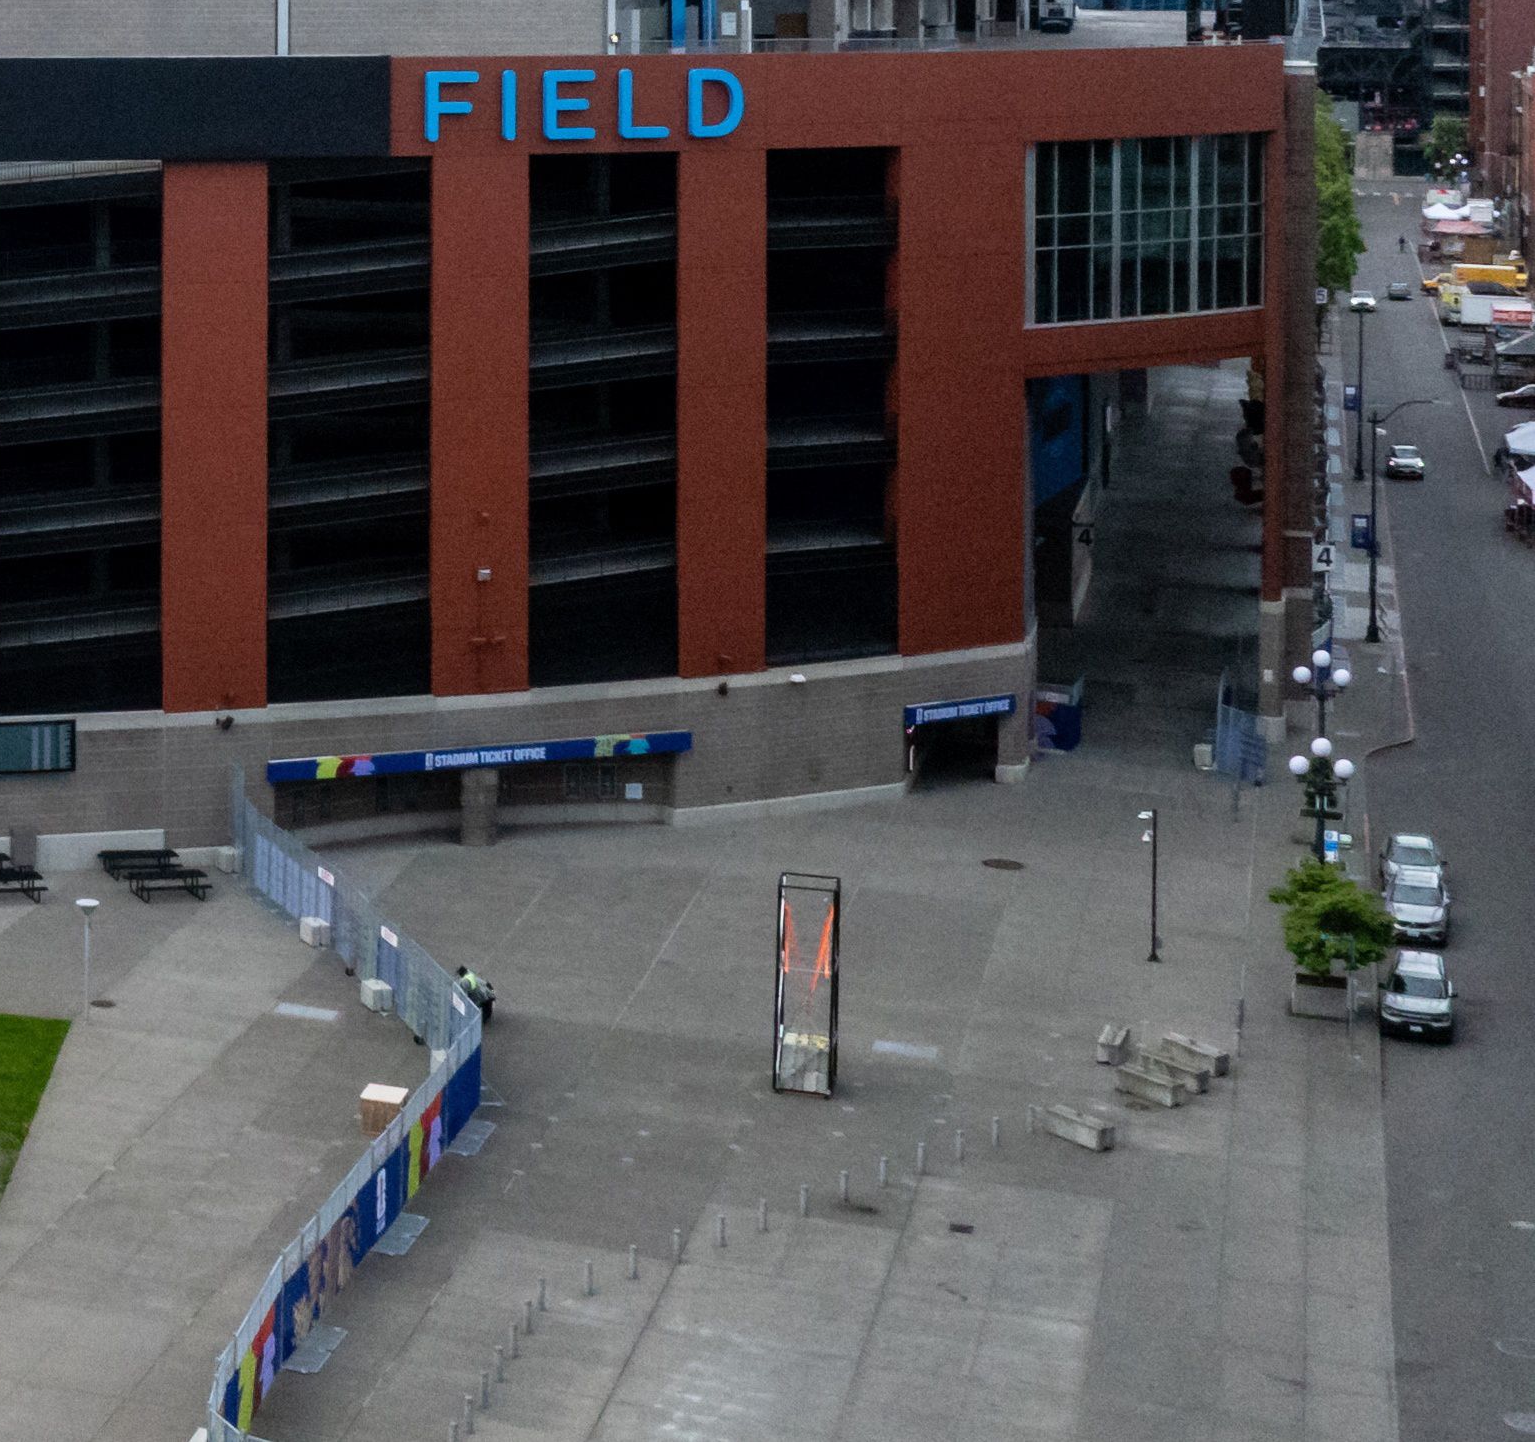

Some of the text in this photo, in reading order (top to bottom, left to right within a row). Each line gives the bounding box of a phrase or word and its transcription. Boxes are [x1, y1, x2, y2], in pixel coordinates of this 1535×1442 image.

[424, 68, 745, 142] FIELD
[1317, 547, 1333, 567] 4
[434, 751, 479, 768] STADIUM
[480, 749, 513, 764] TICKET
[514, 747, 547, 761] OFFICE
